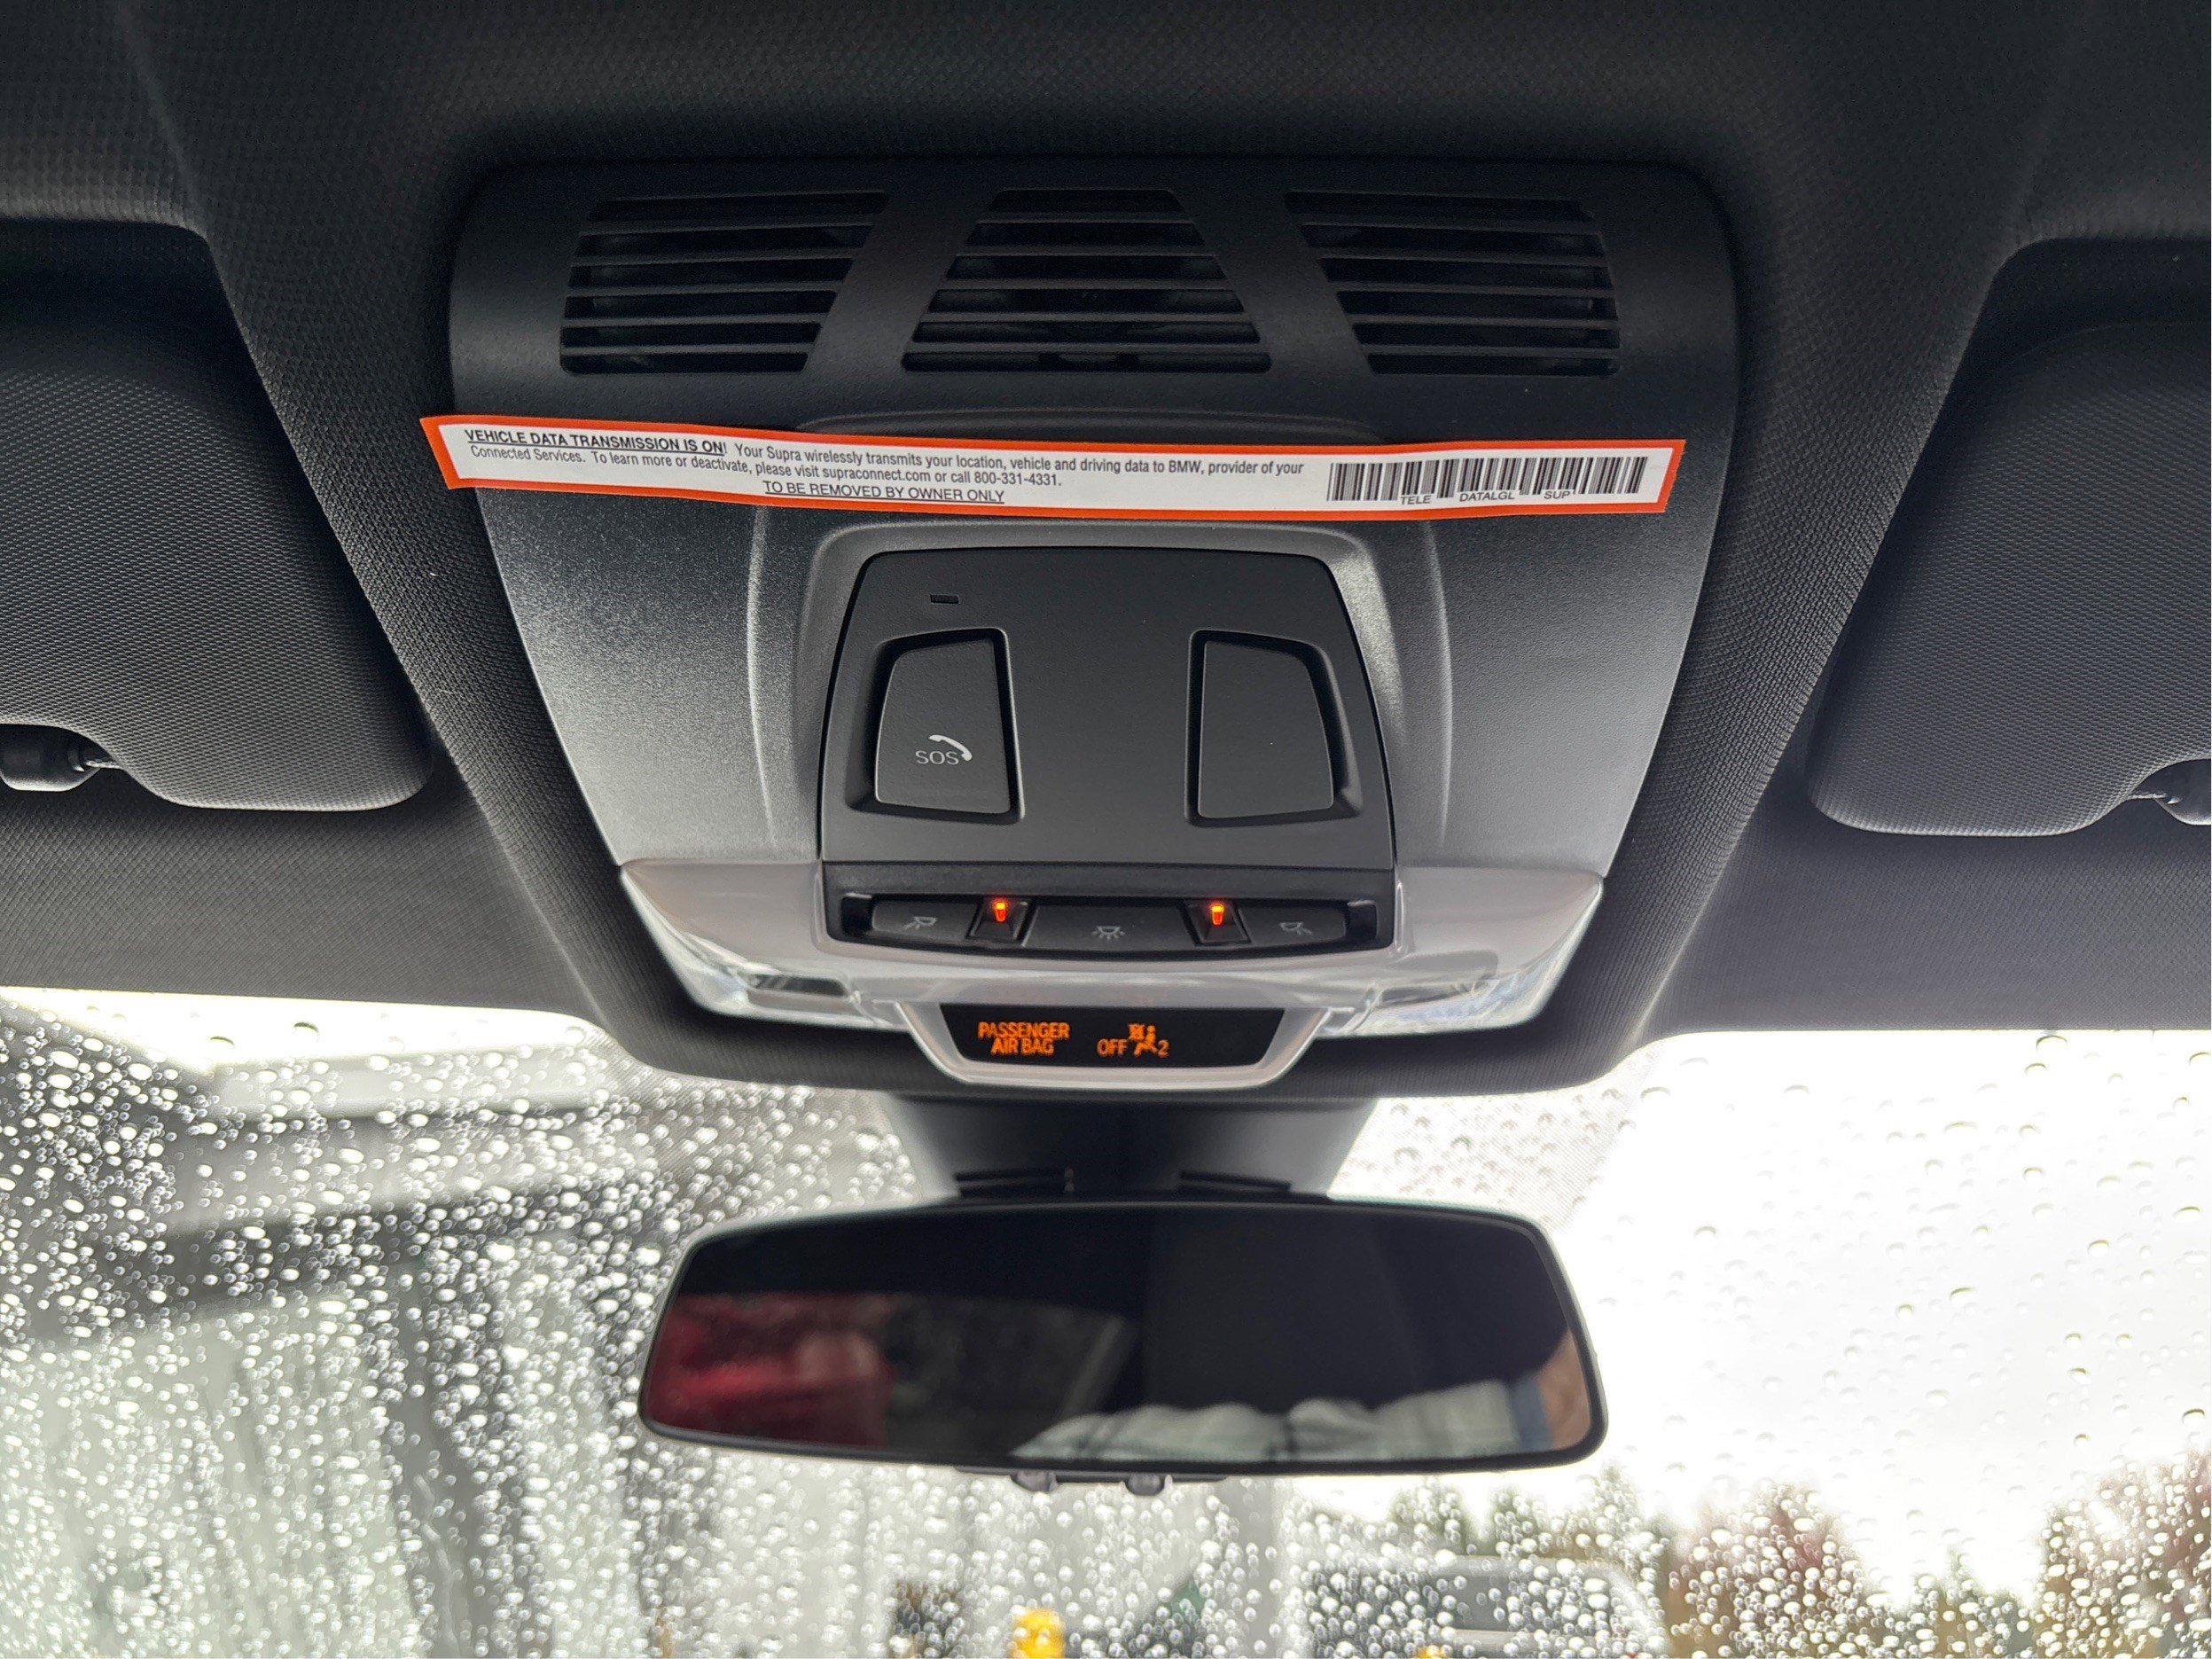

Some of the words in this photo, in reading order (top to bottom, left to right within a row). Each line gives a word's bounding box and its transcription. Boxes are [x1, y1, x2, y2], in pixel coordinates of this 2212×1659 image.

[464, 429, 527, 443] VEHICLE
[530, 433, 566, 445] DATA
[569, 434, 679, 450] TRANSMISSION
[684, 439, 698, 451] IS
[701, 440, 728, 454] ON!
[734, 443, 763, 458] Your
[767, 445, 801, 464] Supra
[804, 449, 863, 467] wirelessly
[866, 451, 923, 466] transmits
[926, 456, 954, 472] your
[957, 454, 1007, 471] location,
[1010, 457, 1051, 471] vehicle
[1054, 458, 1076, 471] and
[1080, 458, 1121, 474] driving
[1124, 459, 1150, 473] data
[1153, 461, 1165, 473] to
[1169, 460, 1204, 475] BMW,
[1208, 461, 1258, 476] provider
[1261, 461, 1273, 474] of
[1276, 464, 1304, 476] your
[470, 444, 531, 461] Connected
[533, 449, 586, 464] Services.
[590, 450, 606, 464] To
[609, 452, 639, 466] learn
[642, 456, 672, 467] more
[675, 457, 688, 468] or
[691, 456, 753, 474] deactivate,
[755, 460, 792, 478] please
[794, 464, 819, 479] visit
[823, 465, 932, 483] supraconnect.com
[934, 471, 948, 483] or
[950, 469, 972, 483] call
[973, 470, 1063, 487] 800-331-4331.
[764, 481, 785, 494] TO
[787, 481, 807, 495] BE
[810, 483, 882, 499] REMOVED
[887, 486, 904, 499] BY
[908, 487, 963, 502] OWNER
[966, 489, 1005, 503] ONLY
[1400, 494, 1431, 505] TELE
[1458, 489, 1516, 503] DATALGL
[1544, 489, 1571, 500] SUP
[915, 750, 959, 764] SOS
[978, 1021, 1070, 1039] PASSENGER
[991, 1038, 1019, 1055] AIR
[1021, 1039, 1055, 1055] BAG
[1097, 1039, 1128, 1056] OFF
